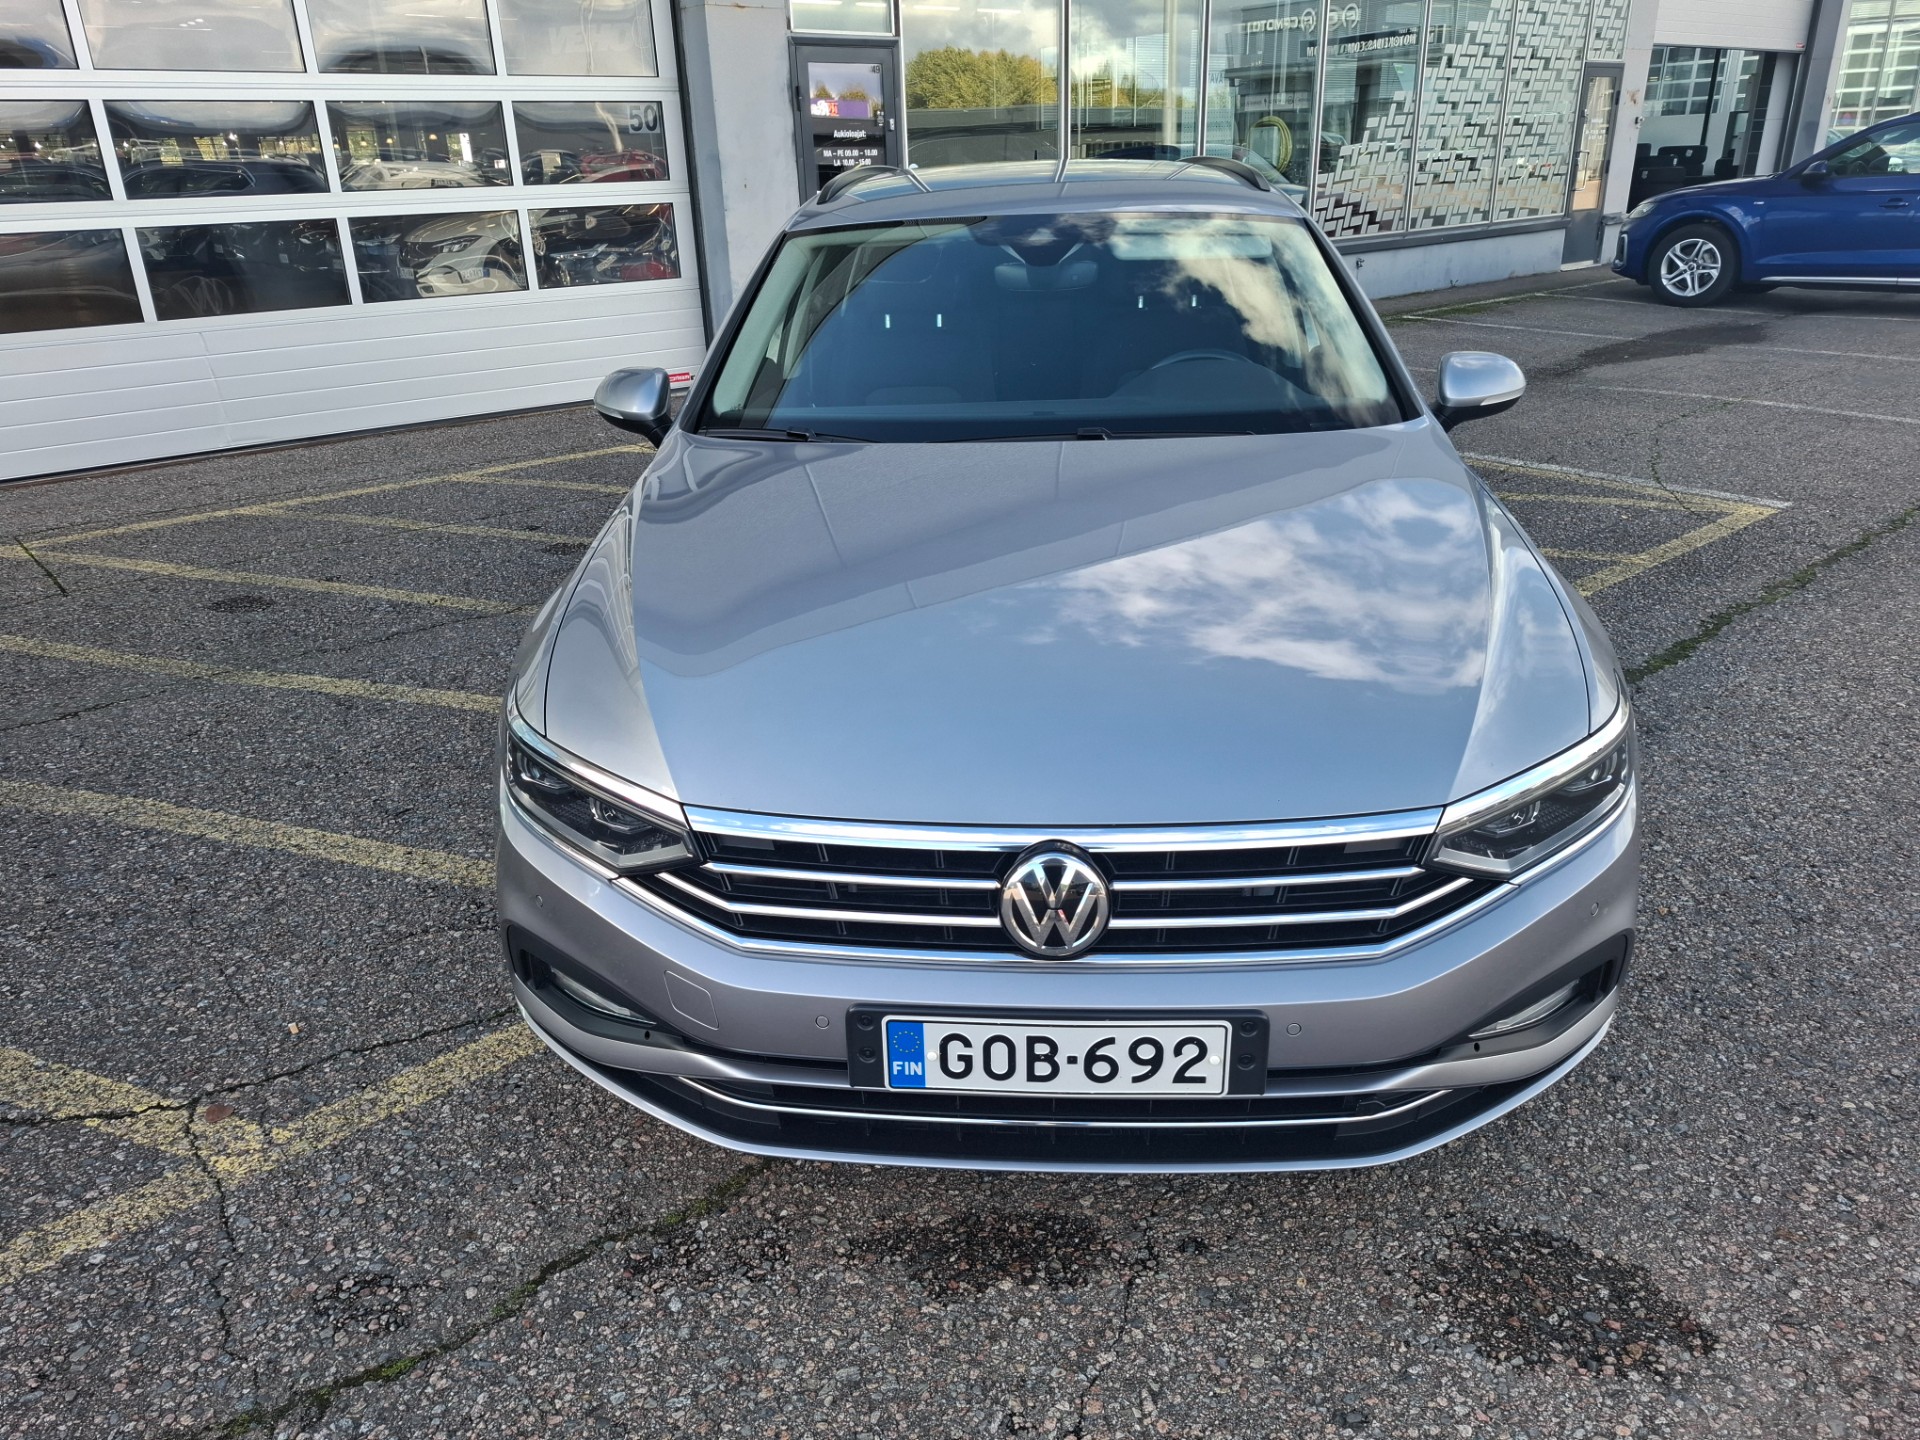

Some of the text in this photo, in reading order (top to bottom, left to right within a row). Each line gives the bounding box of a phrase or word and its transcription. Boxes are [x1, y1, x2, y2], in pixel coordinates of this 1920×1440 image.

[630, 104, 658, 132] 50
[833, 129, 867, 139] Aukioloajat:
[823, 149, 833, 157] MA
[837, 149, 844, 157] PE
[833, 159, 841, 167] LA
[938, 1032, 1209, 1084] GOB-692
[892, 1061, 923, 1076] FIN
